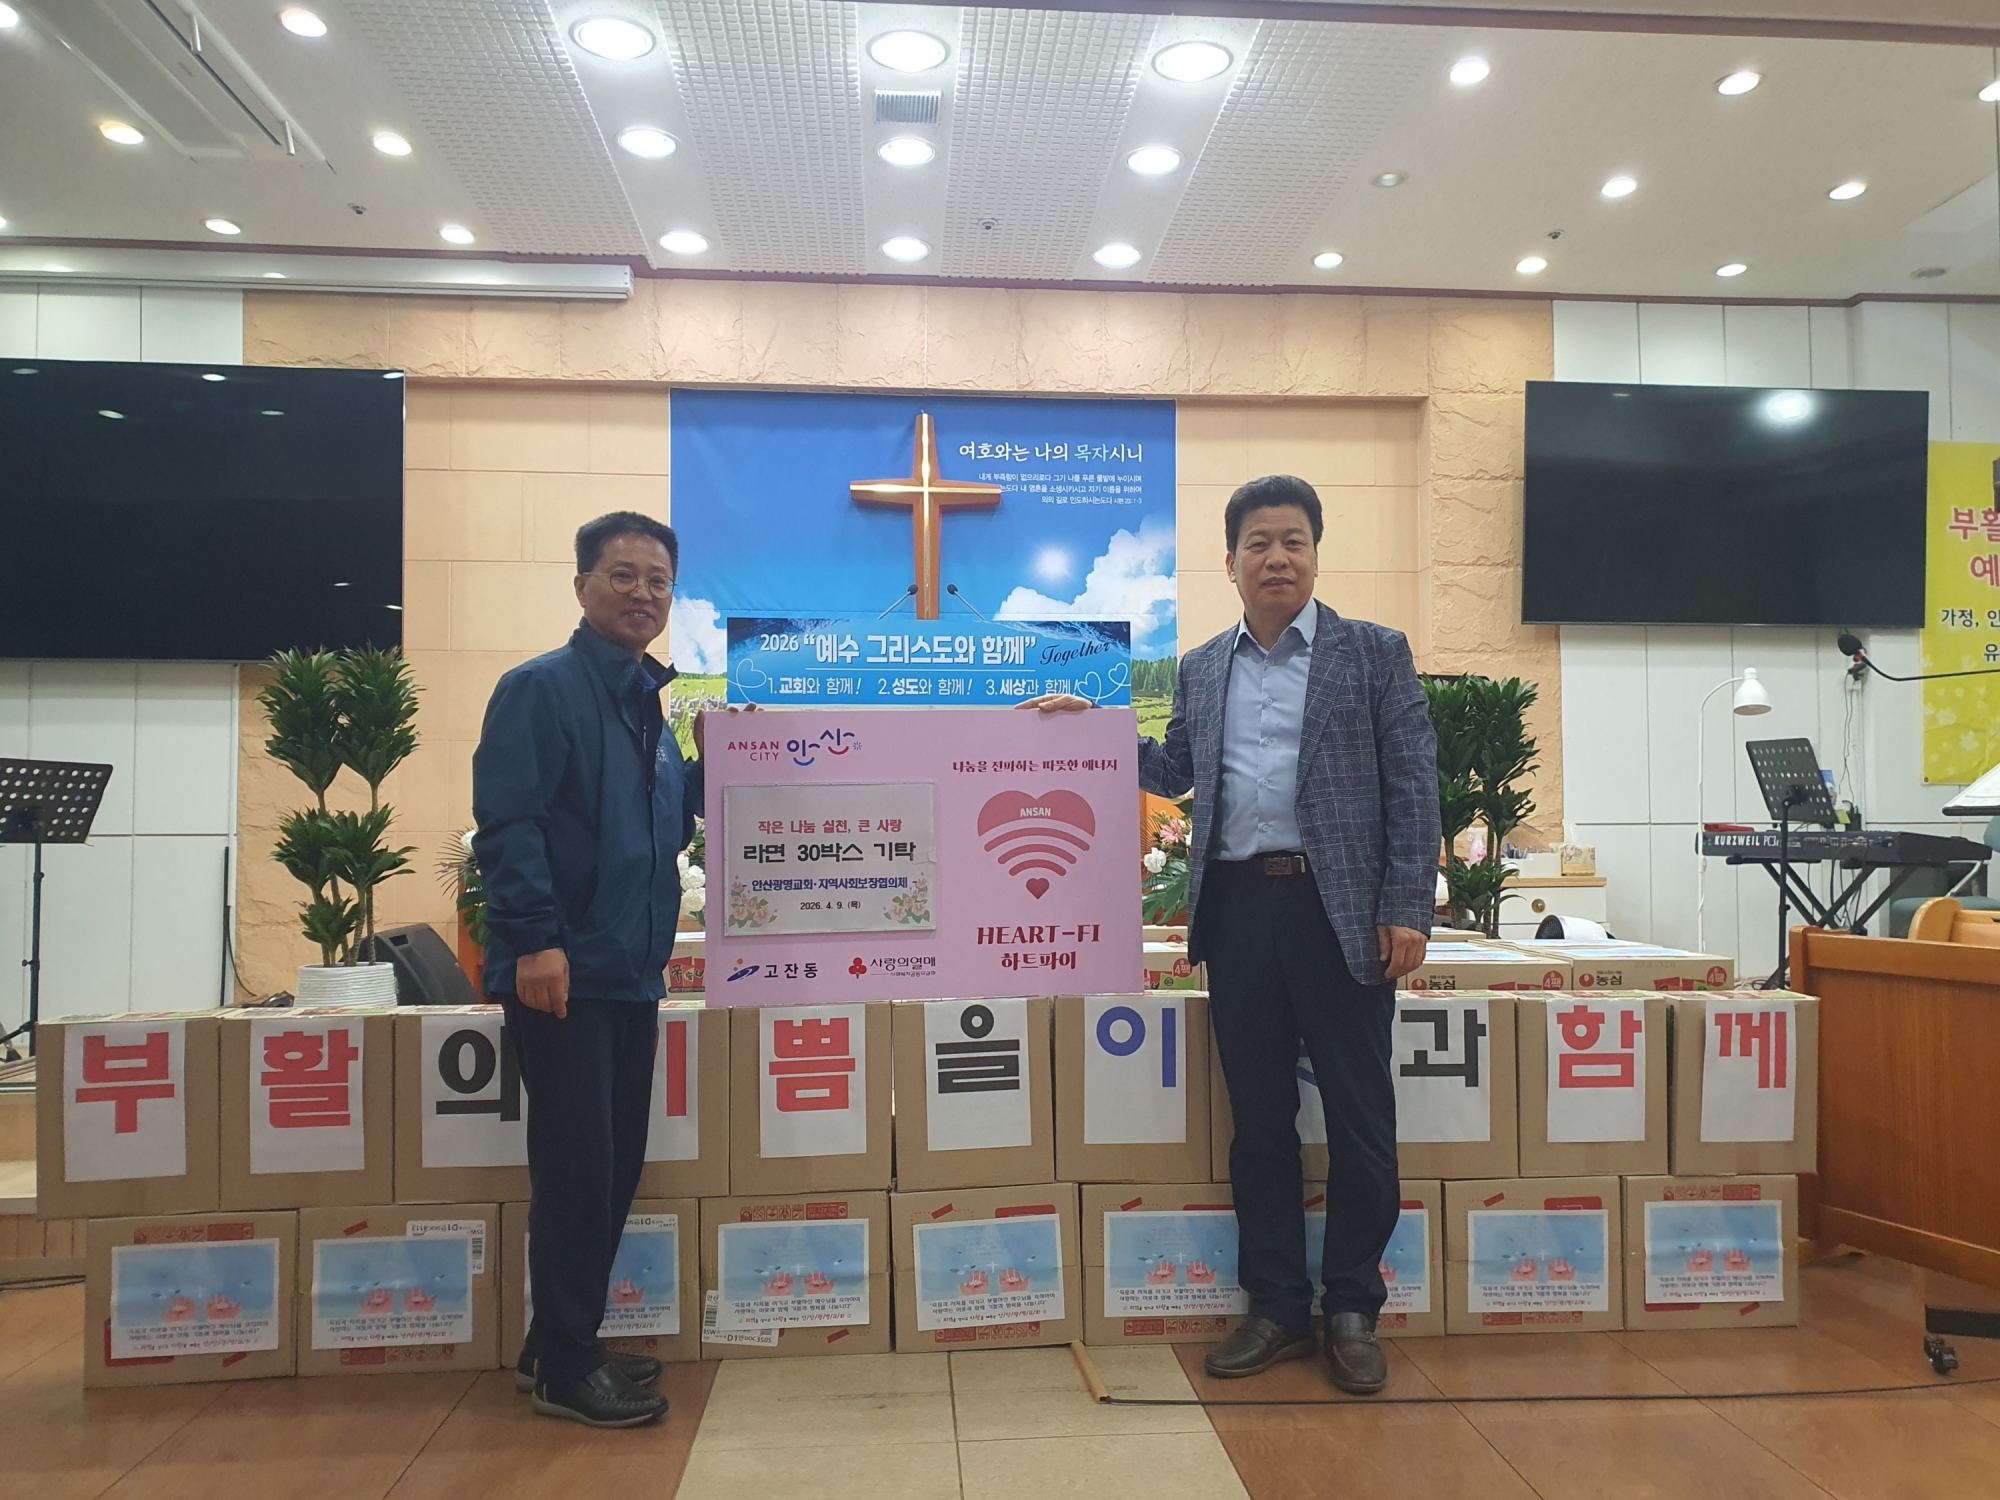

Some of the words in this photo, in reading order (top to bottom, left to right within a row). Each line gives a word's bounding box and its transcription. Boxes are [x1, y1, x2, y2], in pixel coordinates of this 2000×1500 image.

[959, 441, 1030, 463] 여호와는
[1035, 442, 1069, 462] 나의
[1073, 443, 1143, 463] 목자시니
[978, 473, 992, 482] 내게
[993, 473, 1019, 482] 부족함이
[1021, 474, 1052, 483] 없으리로다
[1052, 475, 1066, 483] 그가
[1067, 475, 1080, 483] 나를
[1117, 475, 1142, 484] 누이시며
[1020, 485, 1027, 493] 내
[1028, 485, 1048, 494] 영혼을
[1049, 485, 1087, 494] 소생시키시고
[1088, 486, 1101, 494] 자기
[1102, 486, 1121, 494] 이름을
[1123, 486, 1142, 495] 위하여
[1041, 496, 1055, 504] 의의
[1056, 497, 1068, 505] 길로
[1069, 497, 1113, 505] 인도하시는도다
[1970, 554, 2000, 587] 예
[1941, 609, 1979, 628] 가정,
[760, 633, 799, 652] 2026
[803, 634, 860, 664] “예수
[866, 634, 977, 665] 그리스도와
[982, 635, 1037, 665] 함께”
[1039, 640, 1111, 667] Together
[1984, 643, 2000, 662] 유
[826, 678, 862, 696] 함께!
[938, 678, 973, 696] 함께!
[727, 741, 780, 751] ANSAN
[750, 752, 780, 762] CITY
[952, 760, 989, 773] 나눔을
[1042, 759, 1079, 772] 따뜻한
[1020, 807, 1051, 818] ANSAN
[758, 820, 784, 835] 작은
[790, 820, 816, 835] 나눔
[822, 820, 851, 835] 실천,
[857, 820, 871, 833] 큰
[876, 819, 903, 833] 사랑
[1714, 835, 1760, 846] KURZWEIL
[743, 844, 786, 864] 라면
[797, 843, 864, 862] 30박스
[873, 841, 917, 862] 기탁
[800, 902, 823, 911] 2026.
[825, 901, 834, 910] 4.
[836, 901, 845, 910] 9.
[847, 900, 861, 910] (목)
[976, 924, 1101, 945] HEART-FI
[870, 956, 936, 972] 사랑의열매
[1000, 951, 1077, 971] 하트파이
[763, 962, 819, 979] 고잔동
[1708, 972, 1725, 984] 4팩
[1429, 979, 1456, 990] 농심
[1544, 976, 1561, 989] 4팩
[1595, 975, 1622, 986] 농심
